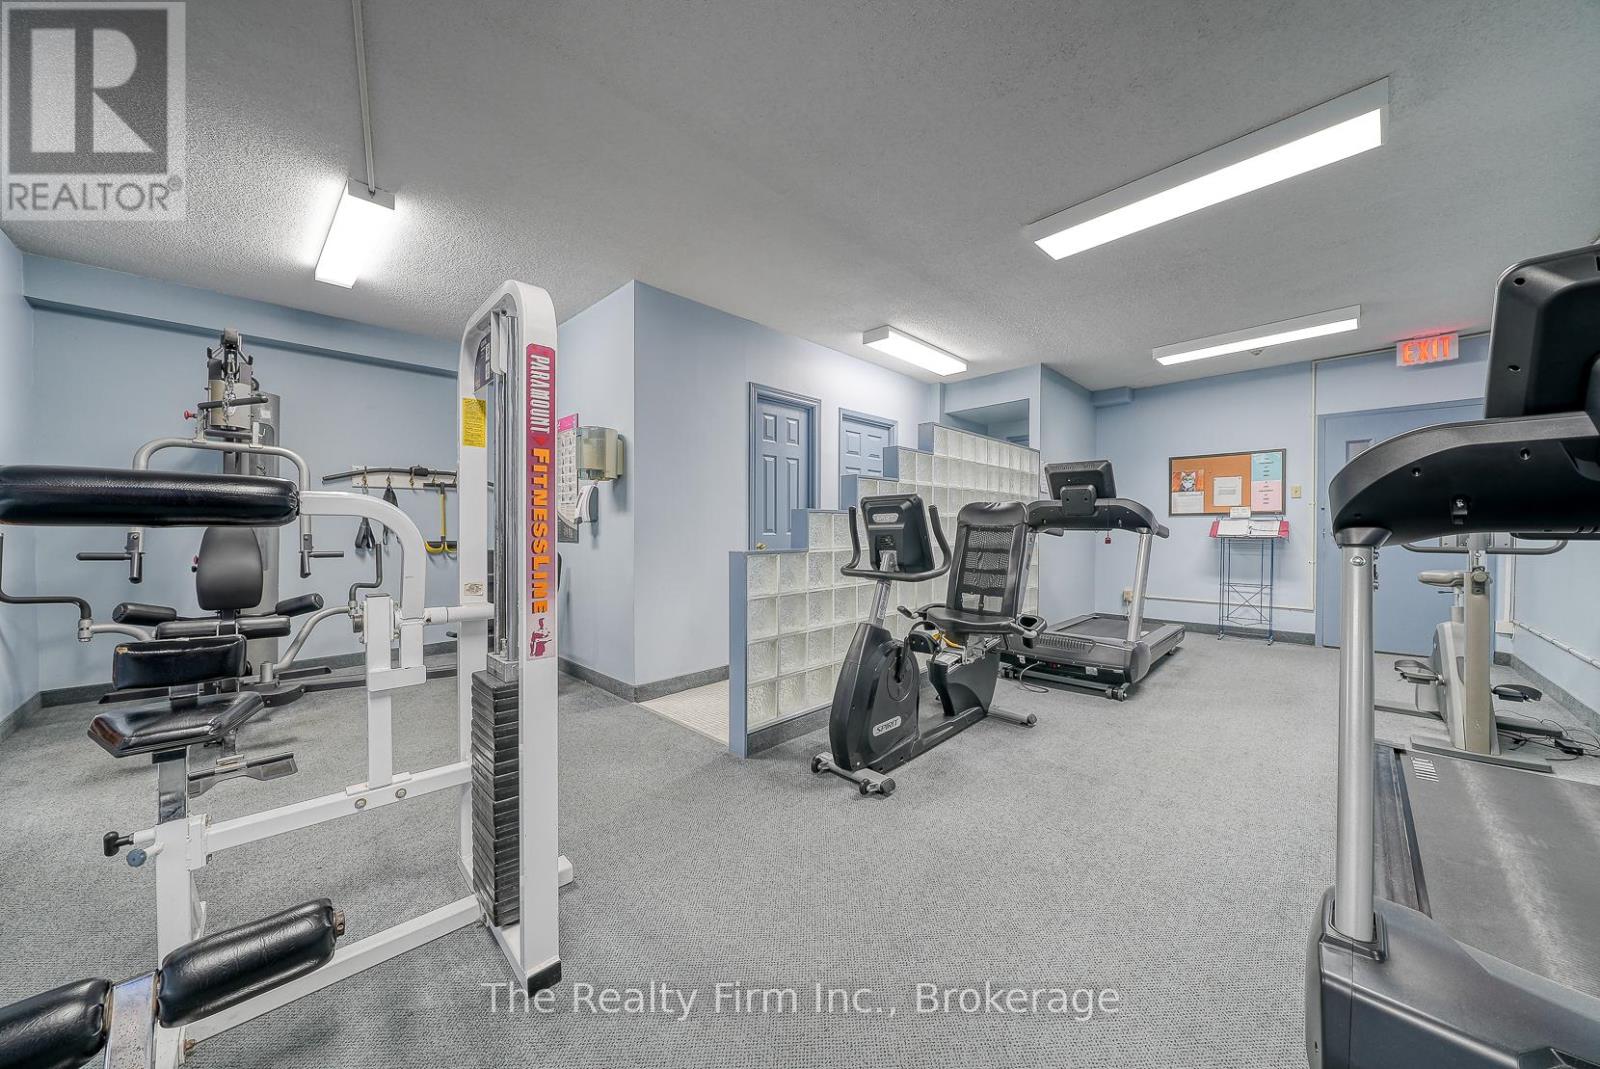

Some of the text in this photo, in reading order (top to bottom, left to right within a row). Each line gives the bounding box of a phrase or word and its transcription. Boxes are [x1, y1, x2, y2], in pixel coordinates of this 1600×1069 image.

[1402, 335, 1455, 364] EXIT
[530, 354, 551, 614] PARAMOUNT FITNESSLINE
